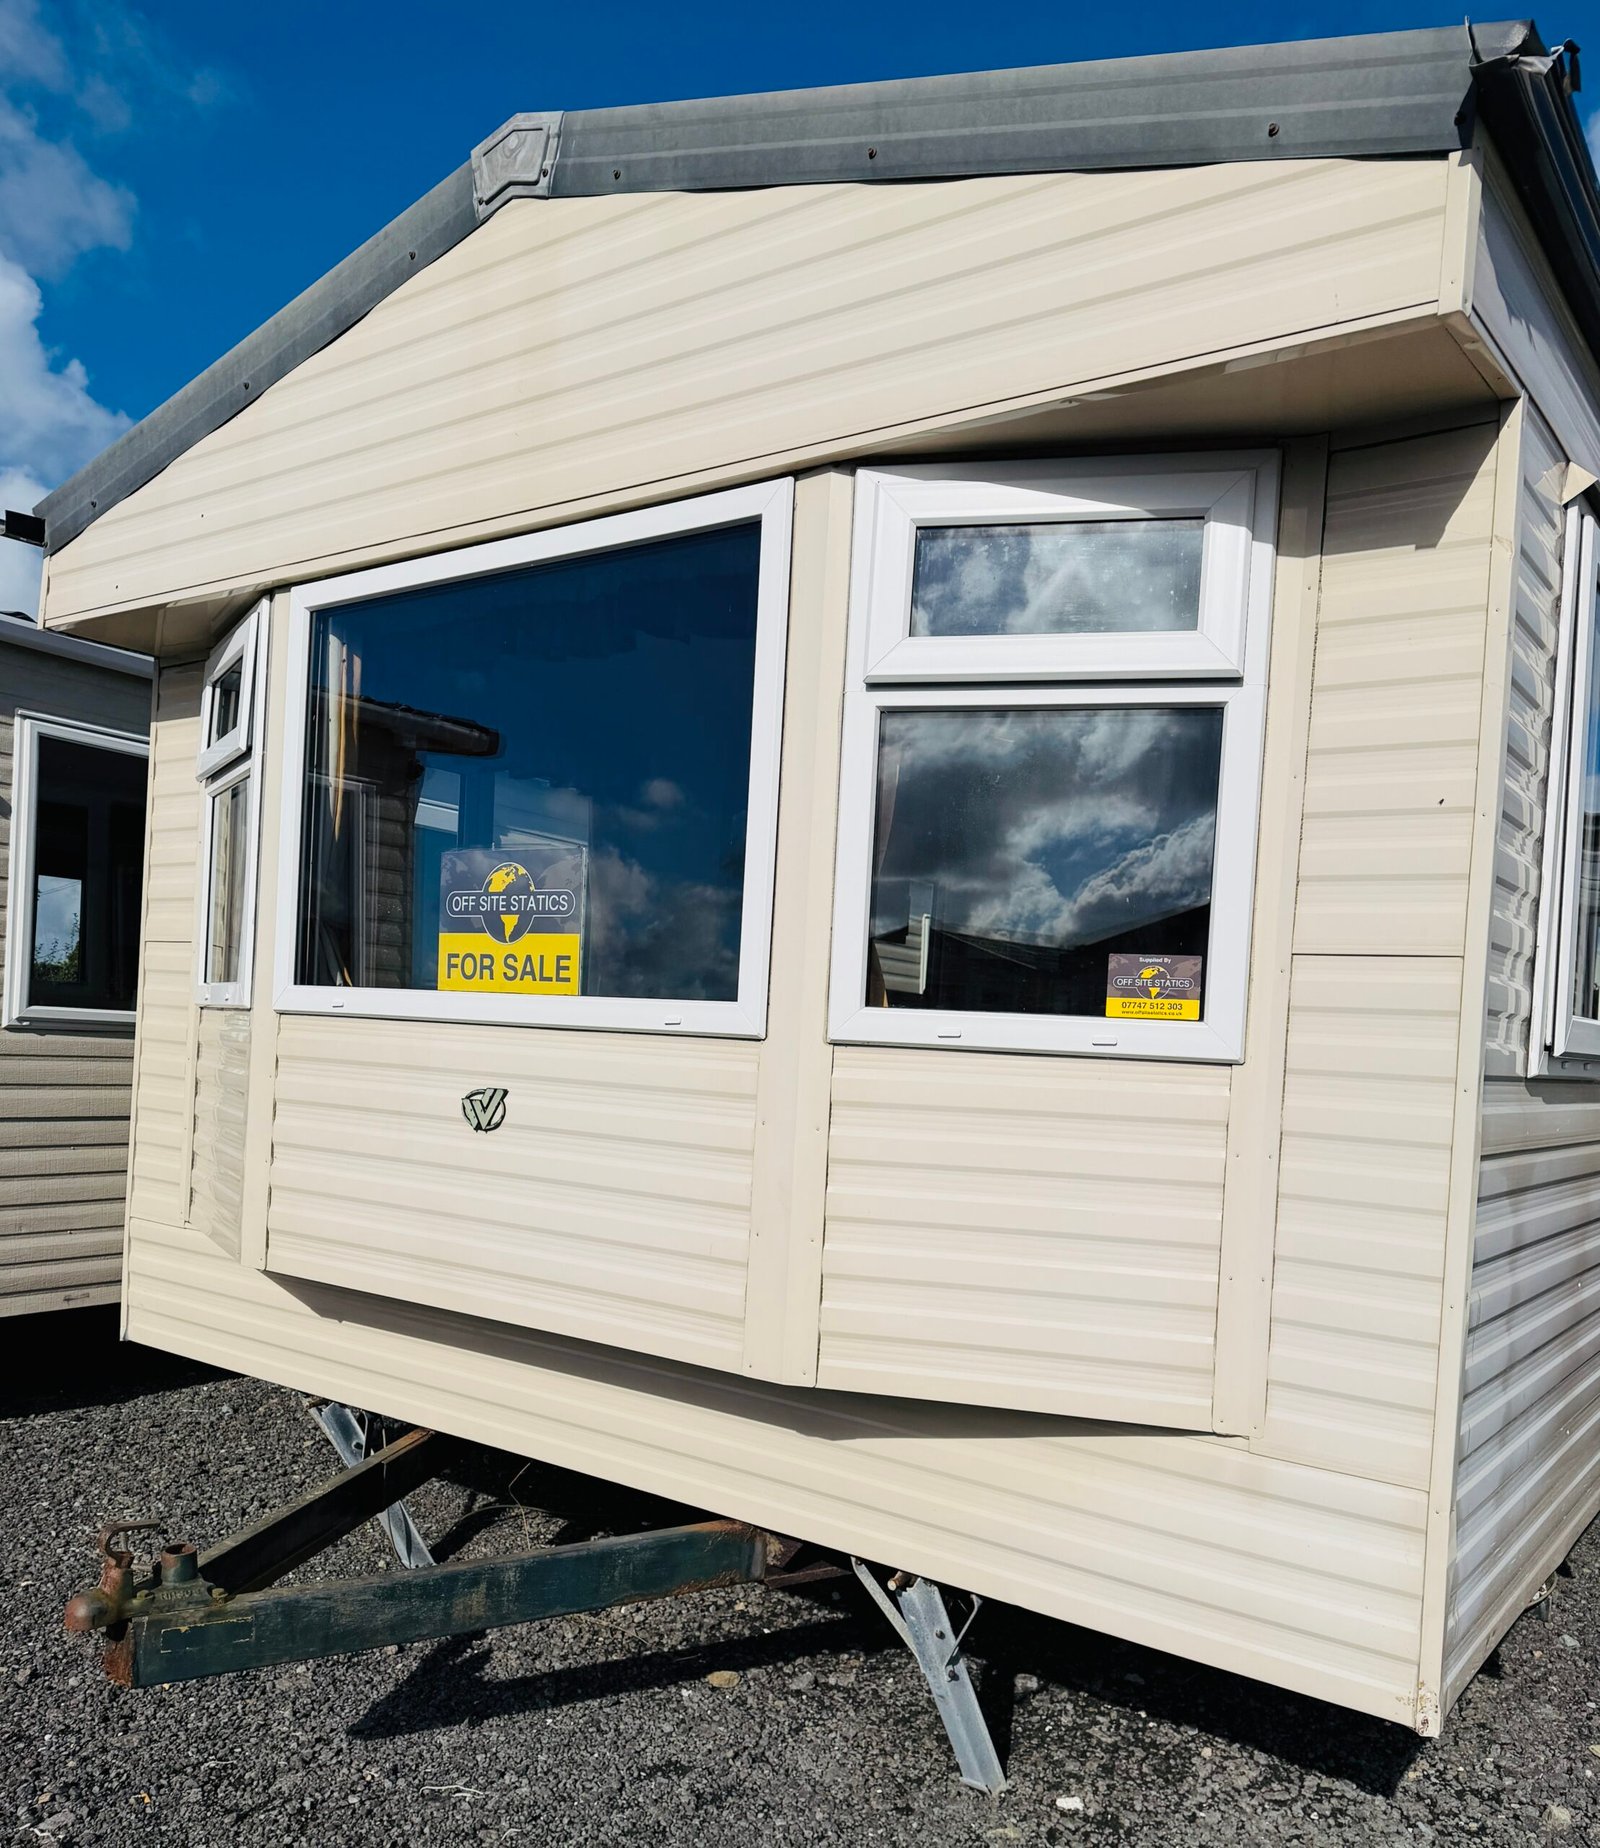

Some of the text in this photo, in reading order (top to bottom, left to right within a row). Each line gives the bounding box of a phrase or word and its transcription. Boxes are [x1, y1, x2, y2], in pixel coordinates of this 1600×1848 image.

[452, 894, 568, 912] OFF SITE STATICS
[446, 953, 571, 983] FOR SALE
[1117, 978, 1190, 987] OFF SITE STATICS
